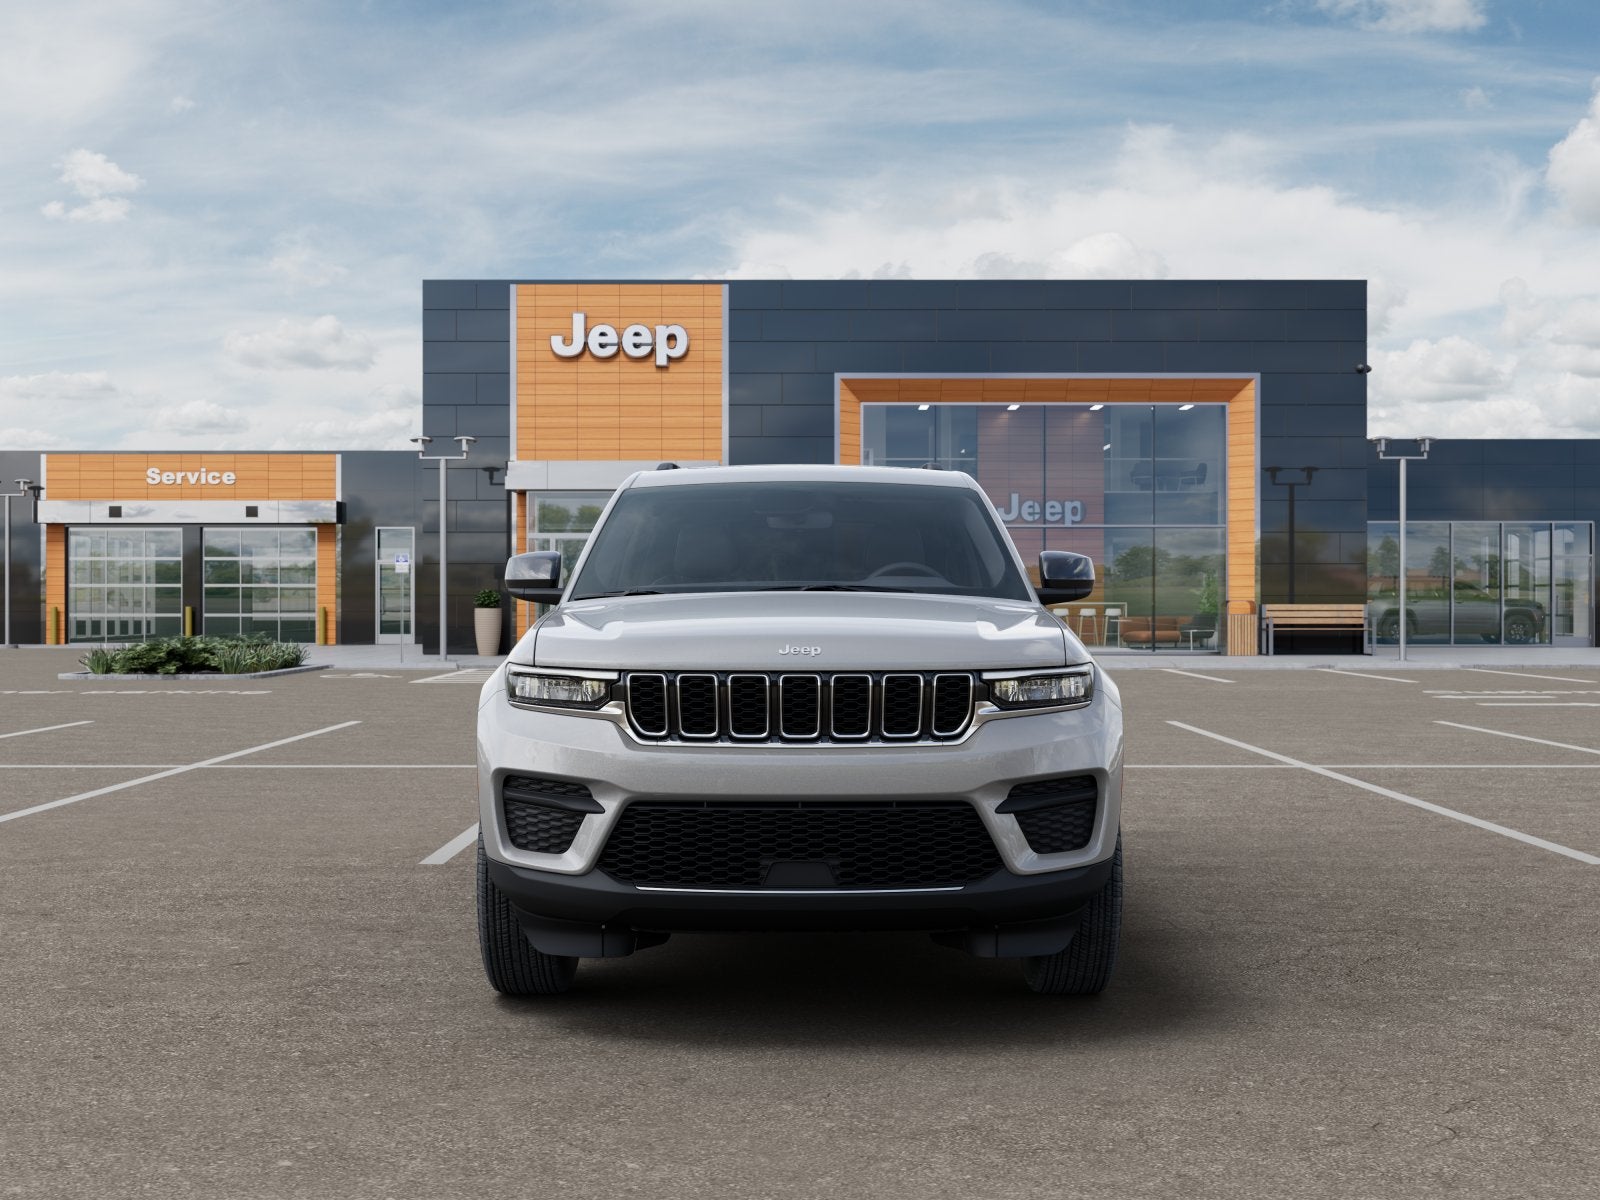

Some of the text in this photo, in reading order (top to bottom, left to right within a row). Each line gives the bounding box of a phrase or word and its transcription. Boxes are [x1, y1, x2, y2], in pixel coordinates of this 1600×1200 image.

[550, 312, 689, 368] Jeep
[146, 467, 236, 485] Service
[998, 493, 1084, 527] Jeep
[778, 644, 821, 657] Jeep
